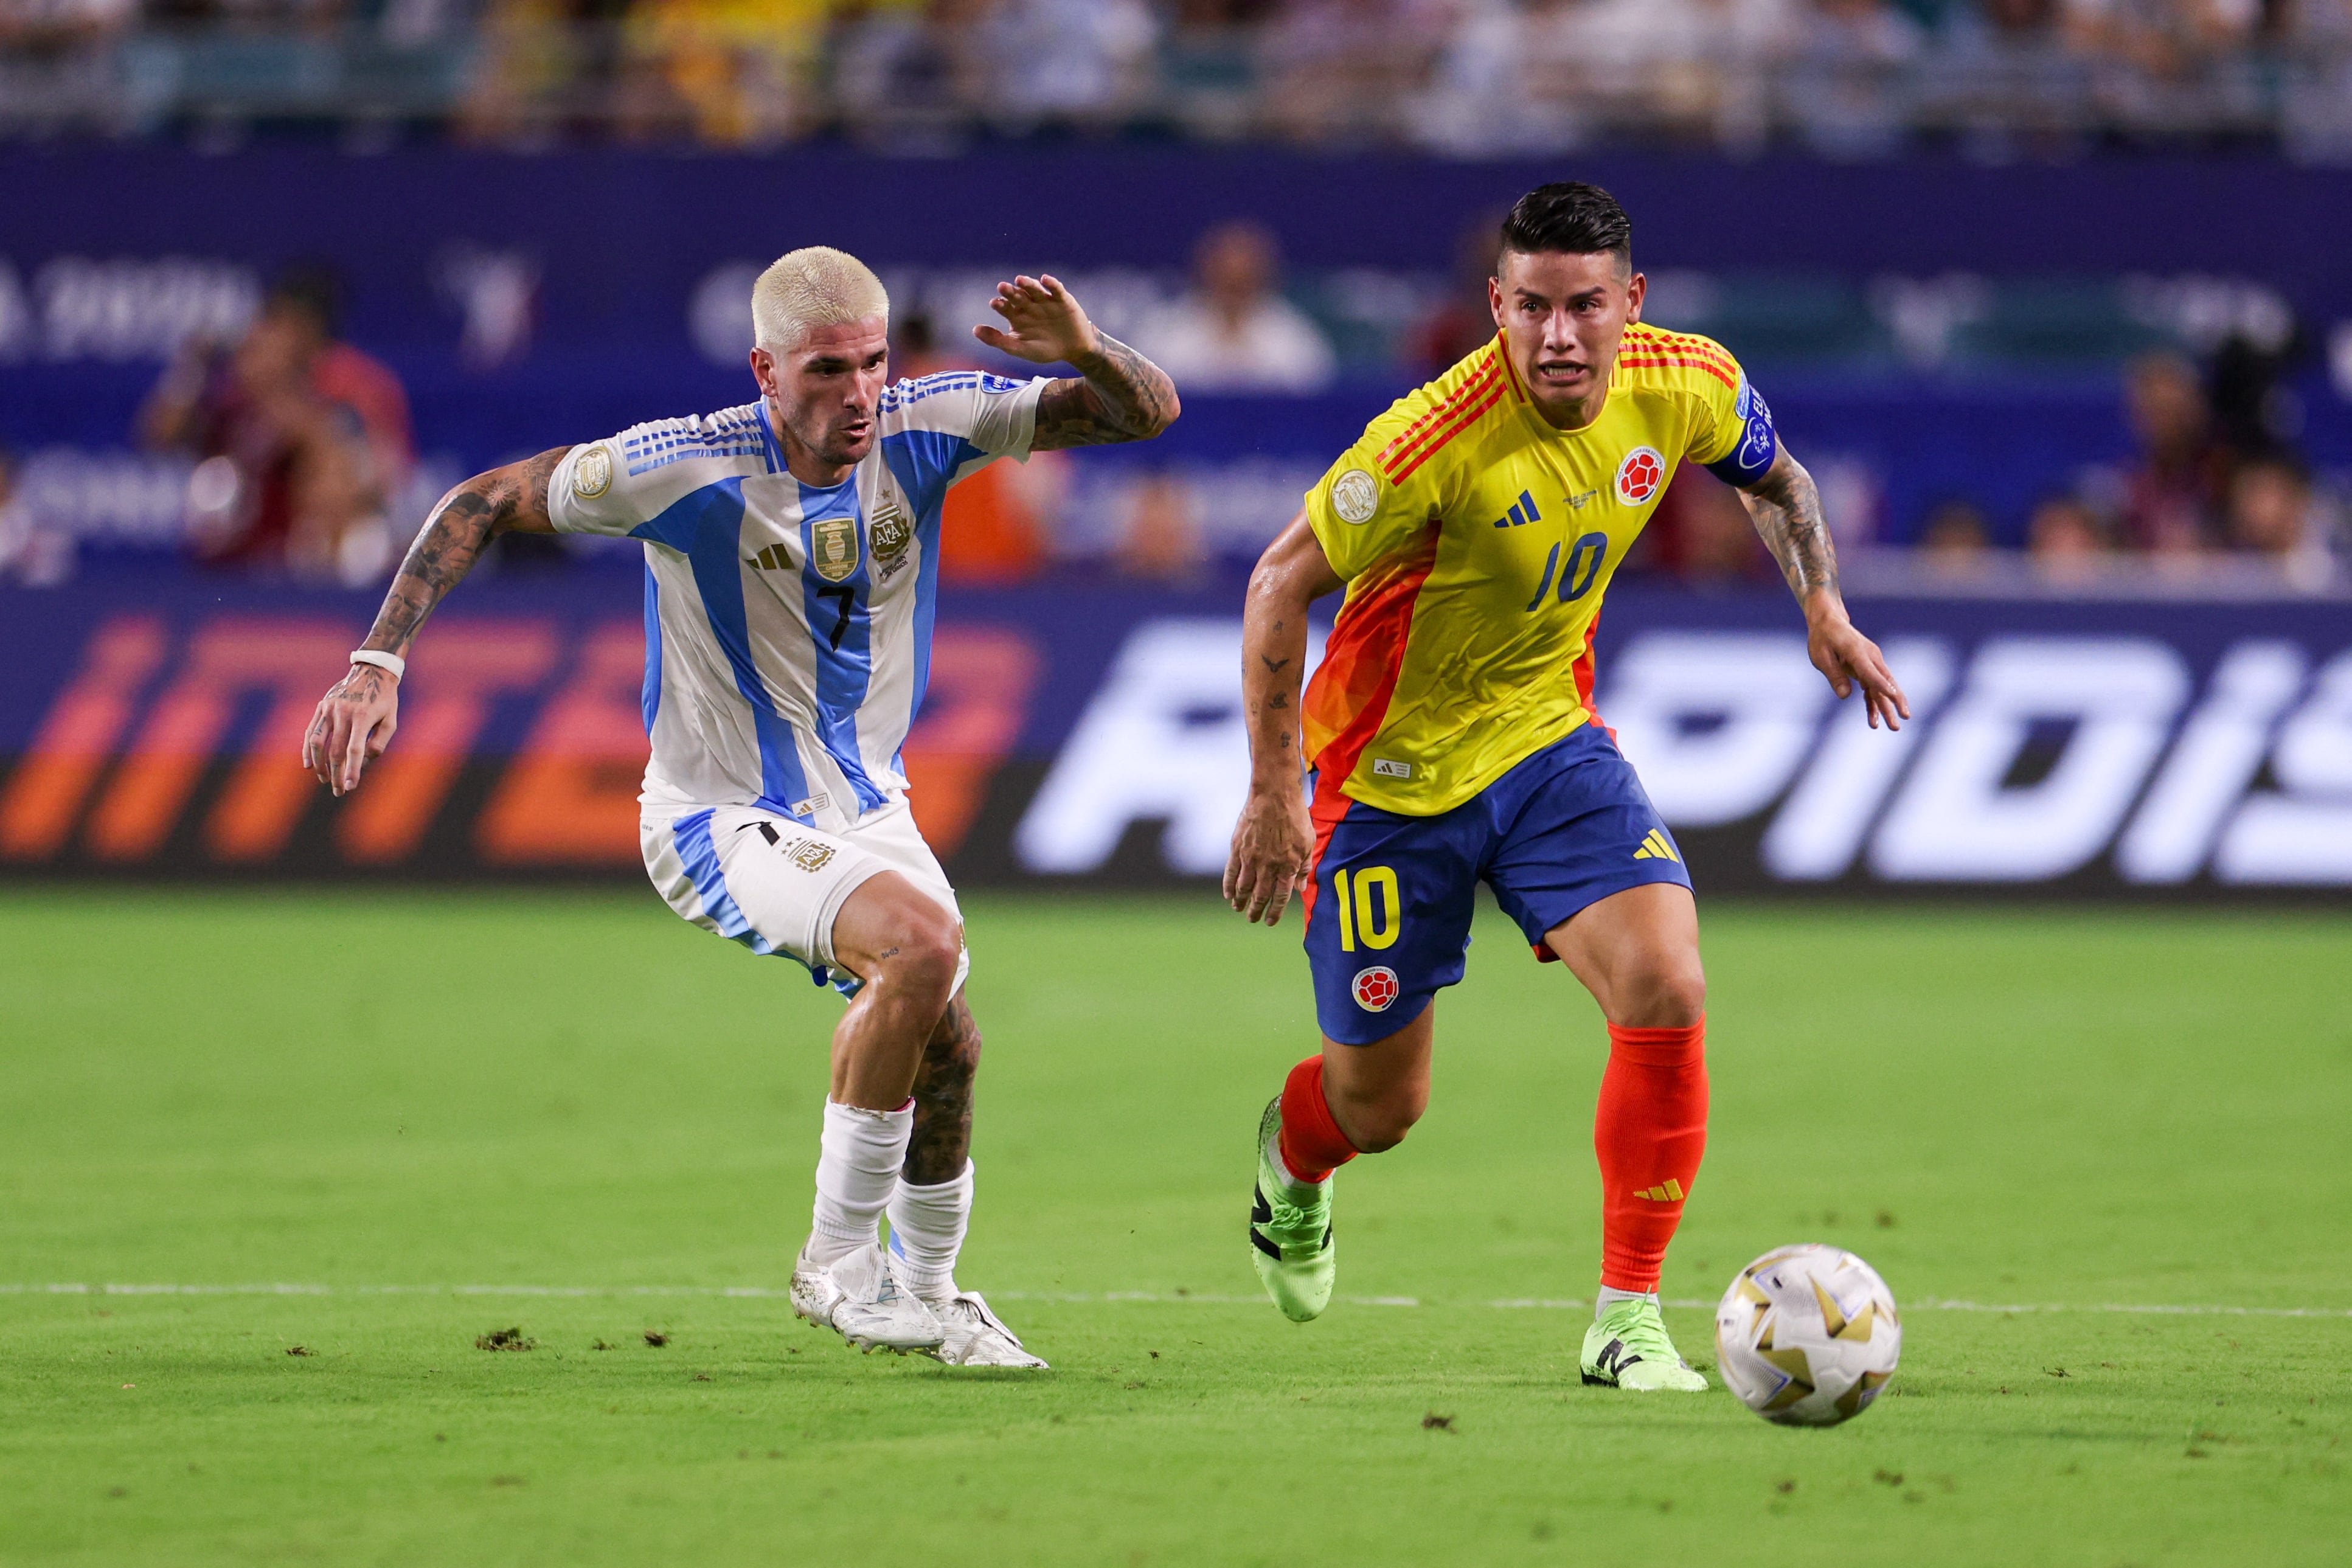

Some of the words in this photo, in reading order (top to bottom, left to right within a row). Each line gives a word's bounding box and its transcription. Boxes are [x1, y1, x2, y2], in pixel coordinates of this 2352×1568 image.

[875, 519, 902, 546] AFA
[1526, 532, 1608, 612] 10
[816, 586, 855, 652] 7
[735, 821, 780, 847] 7
[799, 847, 825, 864] AFA
[1334, 866, 1401, 952] 10
